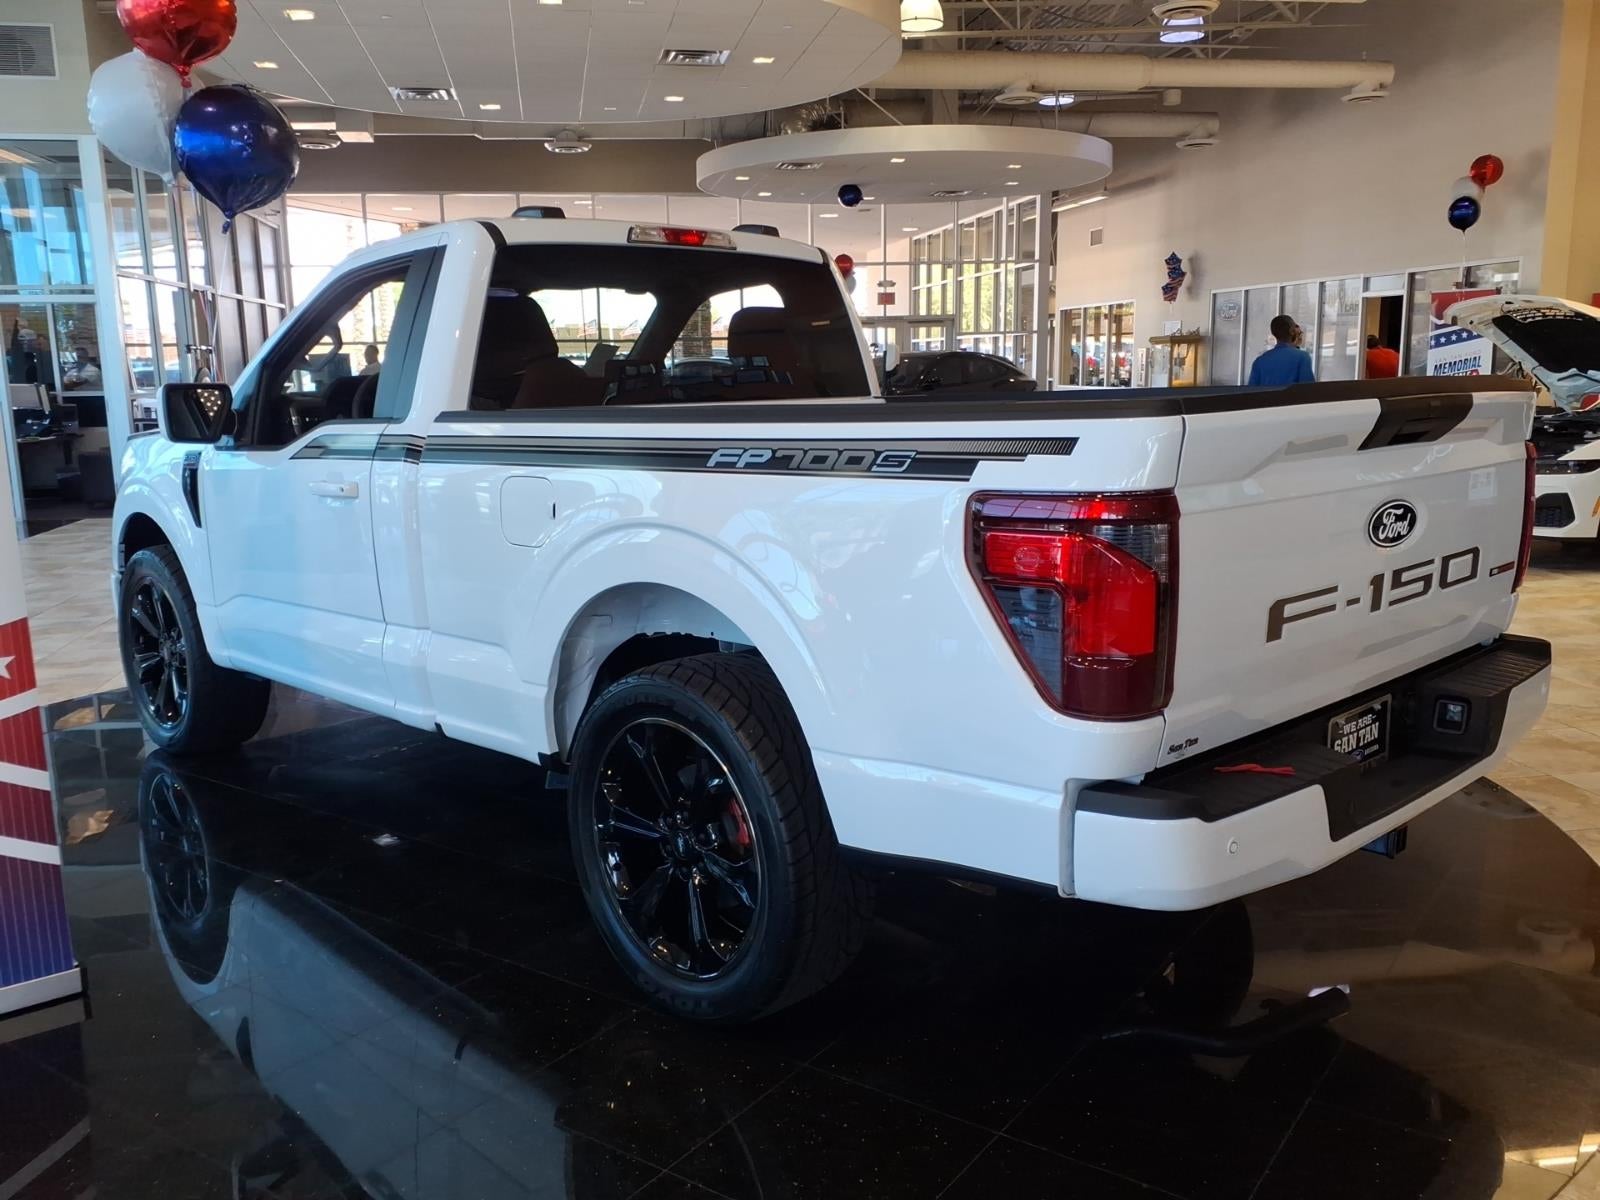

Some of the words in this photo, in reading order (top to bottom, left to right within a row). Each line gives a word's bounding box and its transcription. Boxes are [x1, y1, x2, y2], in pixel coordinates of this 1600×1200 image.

[1433, 355, 1482, 375] MEMORIAL
[706, 447, 917, 473] FP700S
[1378, 507, 1411, 540] Ford
[1265, 546, 1481, 643] F-150
[1334, 732, 1358, 753] SAN
[1358, 721, 1379, 746] TAN
[1343, 721, 1357, 735] WE
[1357, 714, 1373, 729] ARE
